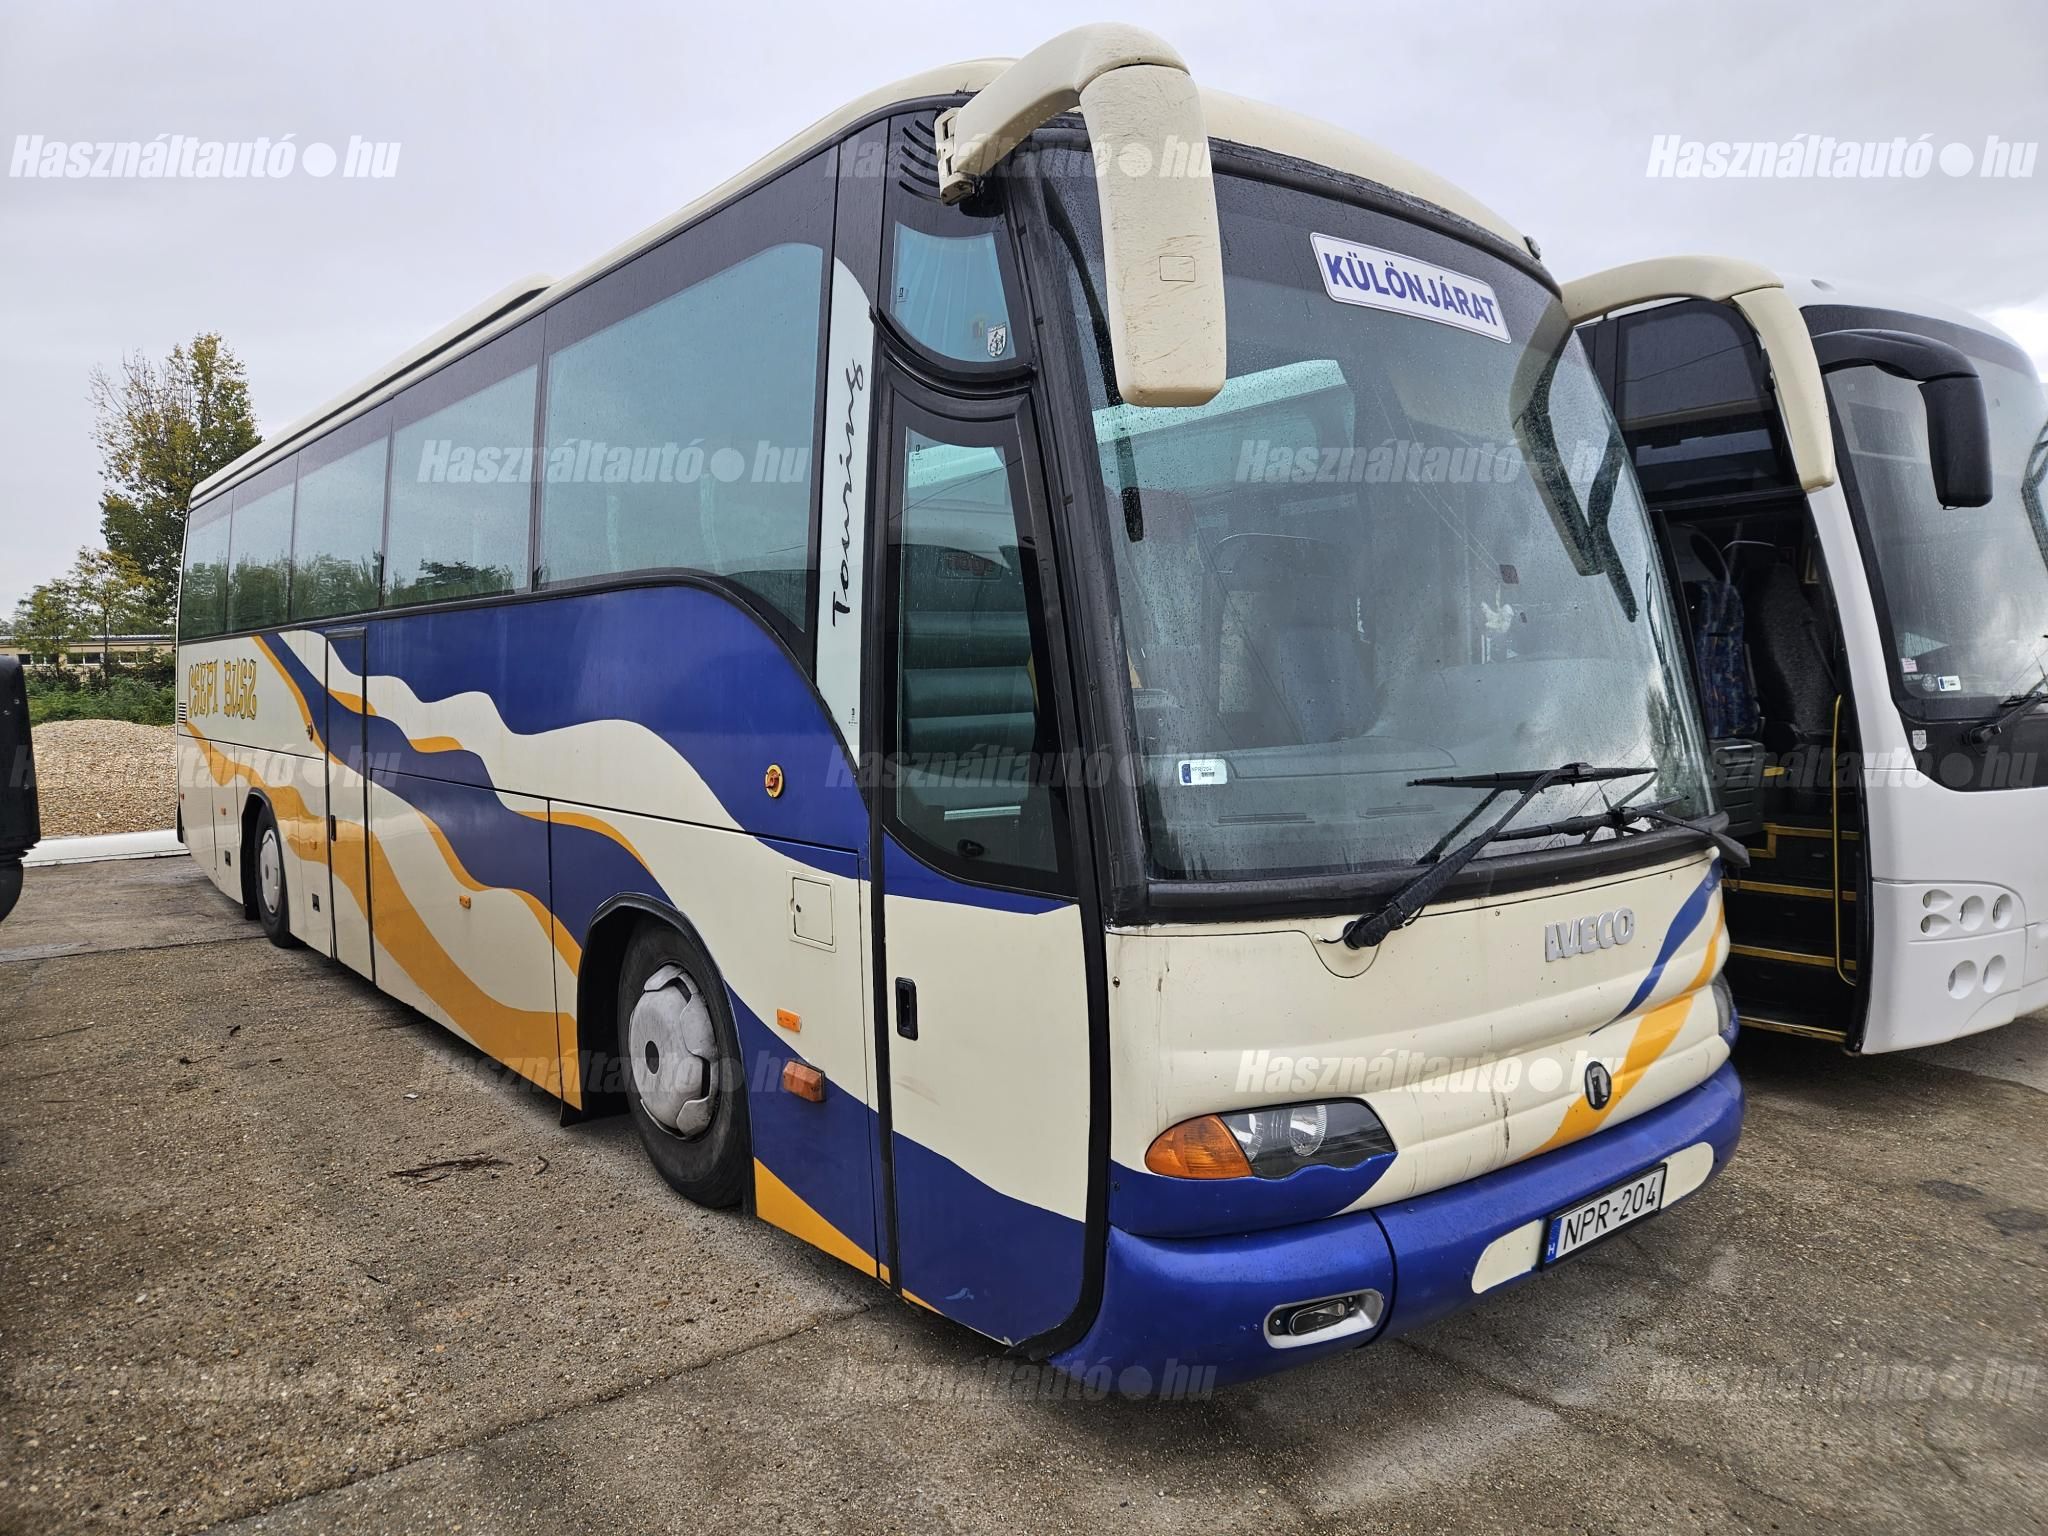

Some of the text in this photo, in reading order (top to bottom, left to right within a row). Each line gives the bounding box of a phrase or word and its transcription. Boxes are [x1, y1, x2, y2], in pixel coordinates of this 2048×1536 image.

[1323, 251, 1498, 326] KÜLÖNJÁRAT
[1544, 906, 1635, 963] IVECO
[1562, 1176, 1657, 1250] NPR-204
